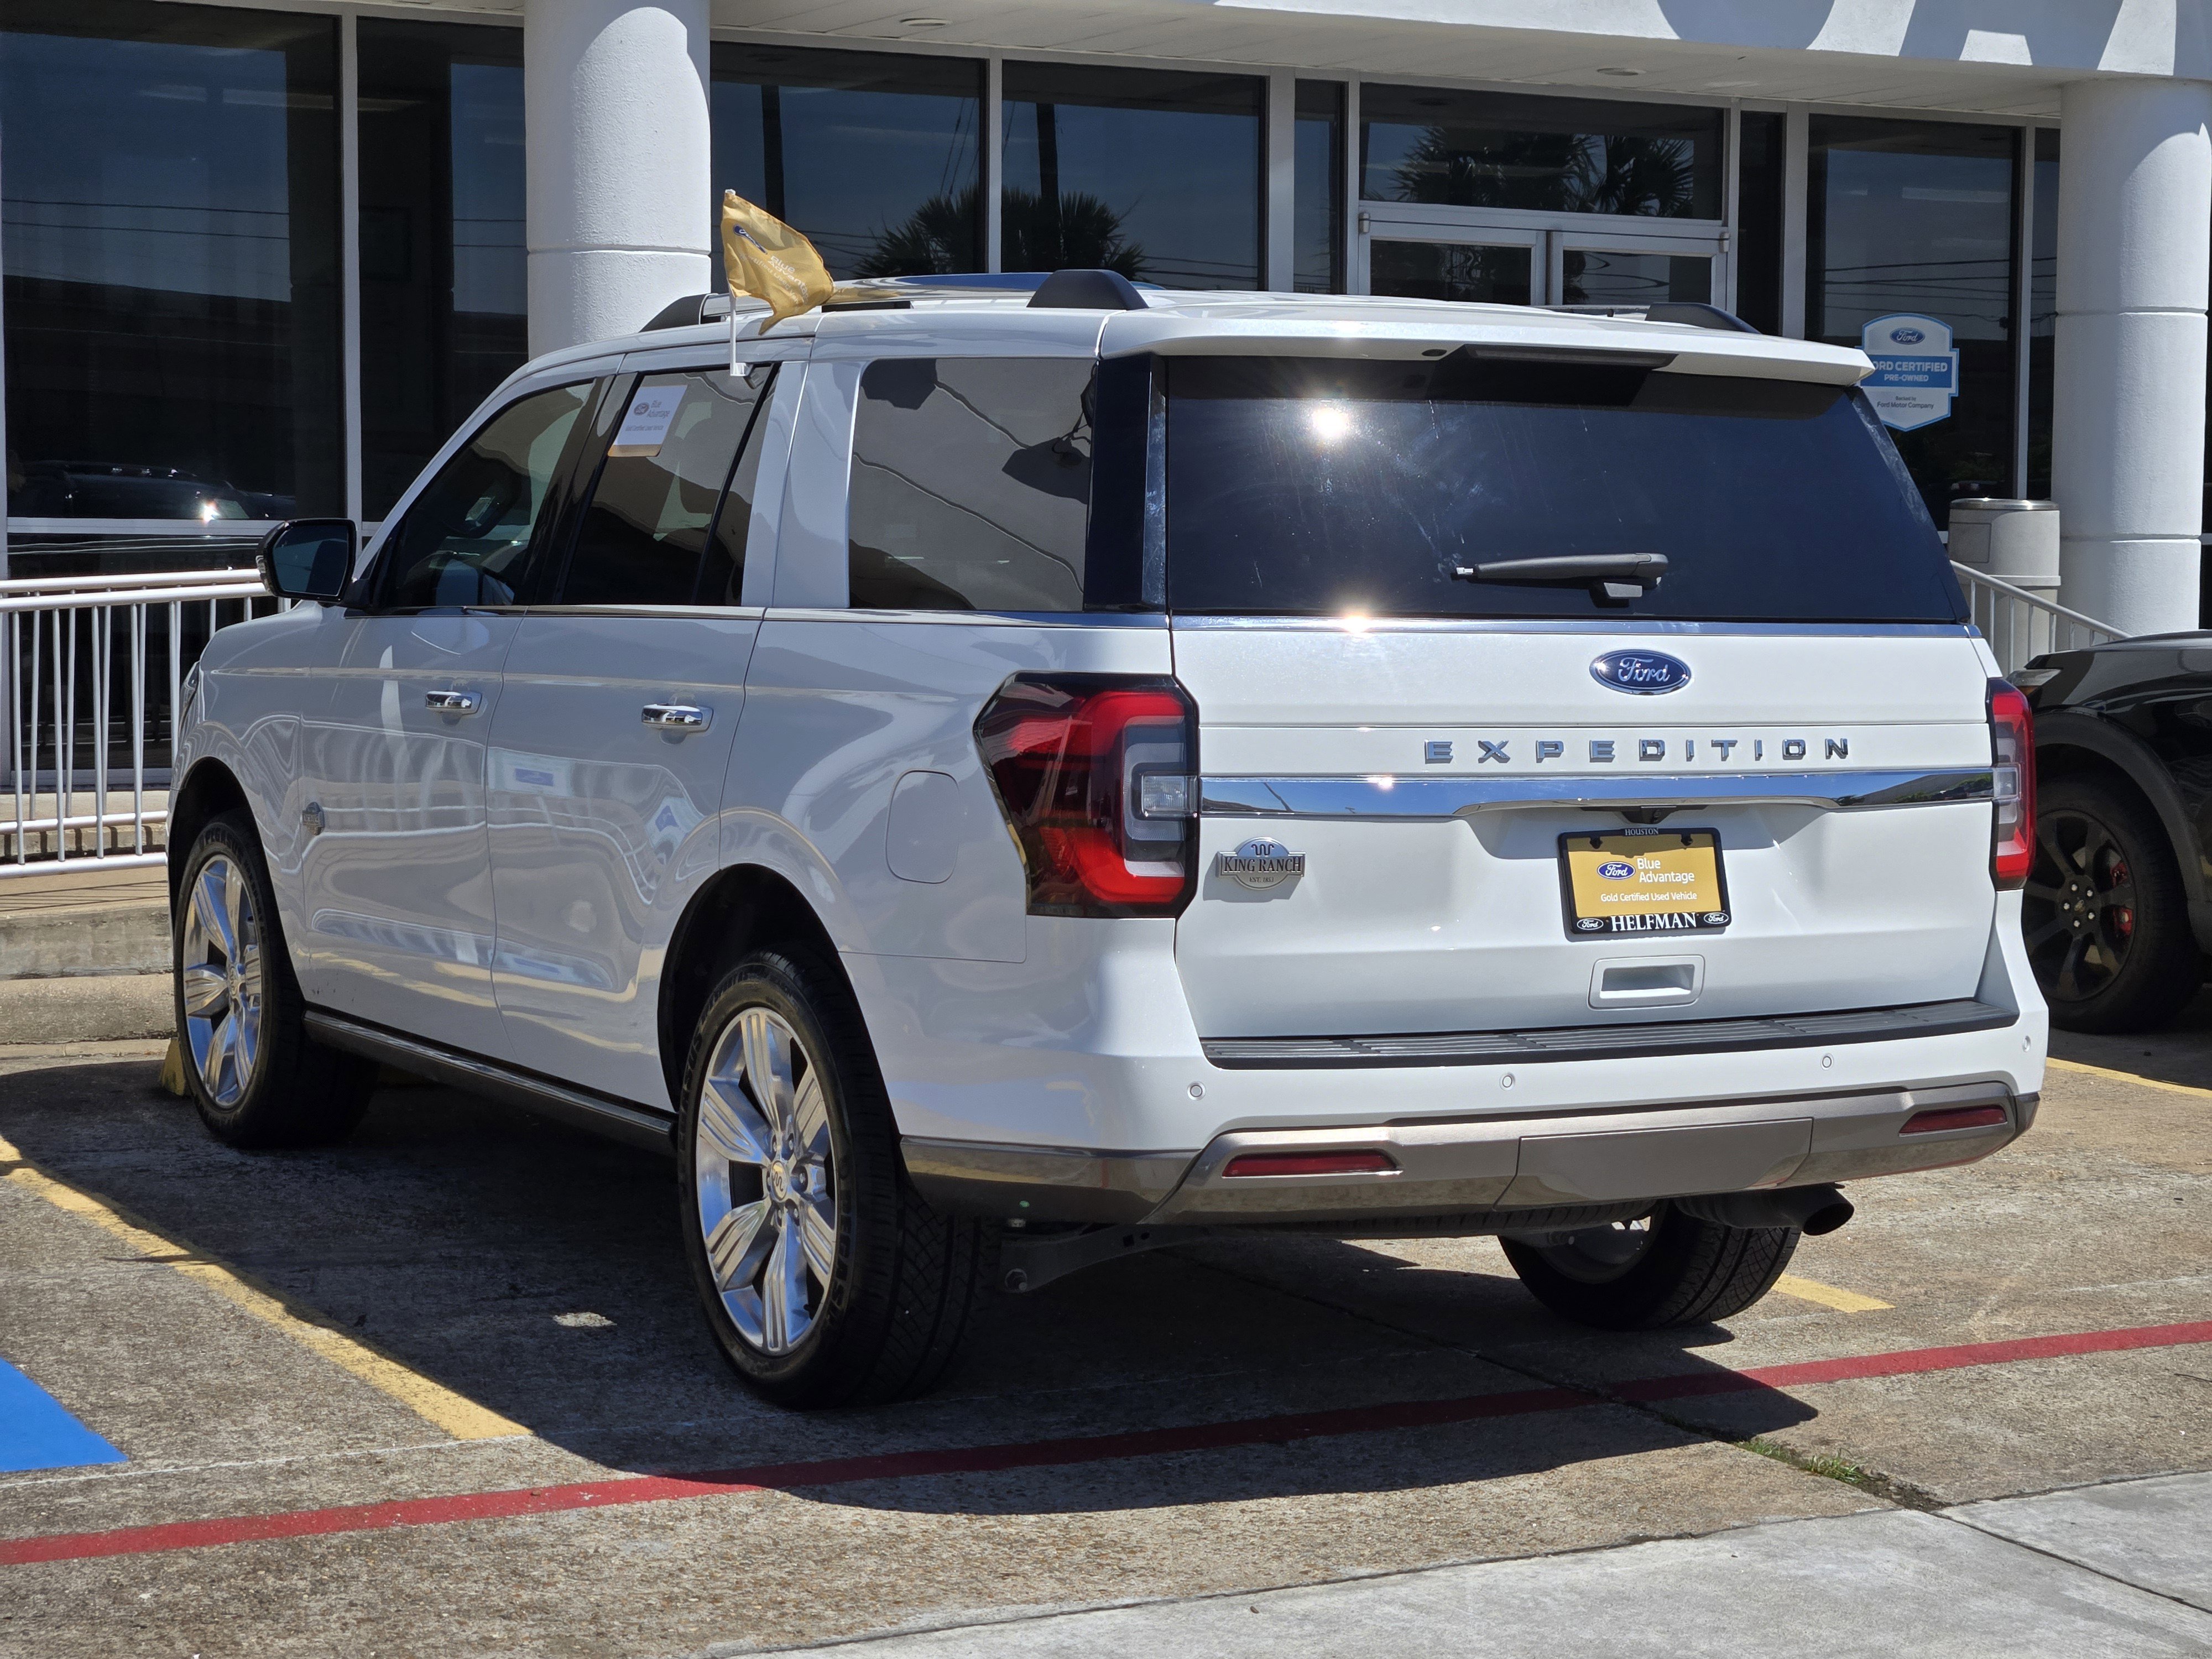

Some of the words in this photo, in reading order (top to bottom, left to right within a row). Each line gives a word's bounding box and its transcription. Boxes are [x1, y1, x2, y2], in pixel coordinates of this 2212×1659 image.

[770, 255, 796, 274] Blue
[1897, 330, 1918, 342] Ford
[1872, 361, 1893, 371] ORD
[1895, 361, 1948, 372] CERTIFIED
[1617, 657, 1671, 684] Ford
[1423, 738, 1849, 763] EXPEDITION
[1625, 828, 1659, 836] HOUSTON
[1224, 857, 1255, 873] KING
[1259, 857, 1302, 873] RANCH
[1605, 863, 1629, 877] Ford
[1636, 858, 1661, 870] Blue
[1639, 871, 1695, 884] Advantage
[1600, 893, 1618, 902] Gold
[1620, 893, 1650, 901] Certified
[1651, 892, 1670, 901] Used
[1671, 891, 1697, 900] Vehicle
[1582, 920, 1599, 928] Ford
[1610, 912, 1697, 931] HELFMAN
[1708, 914, 1725, 922] Ford
